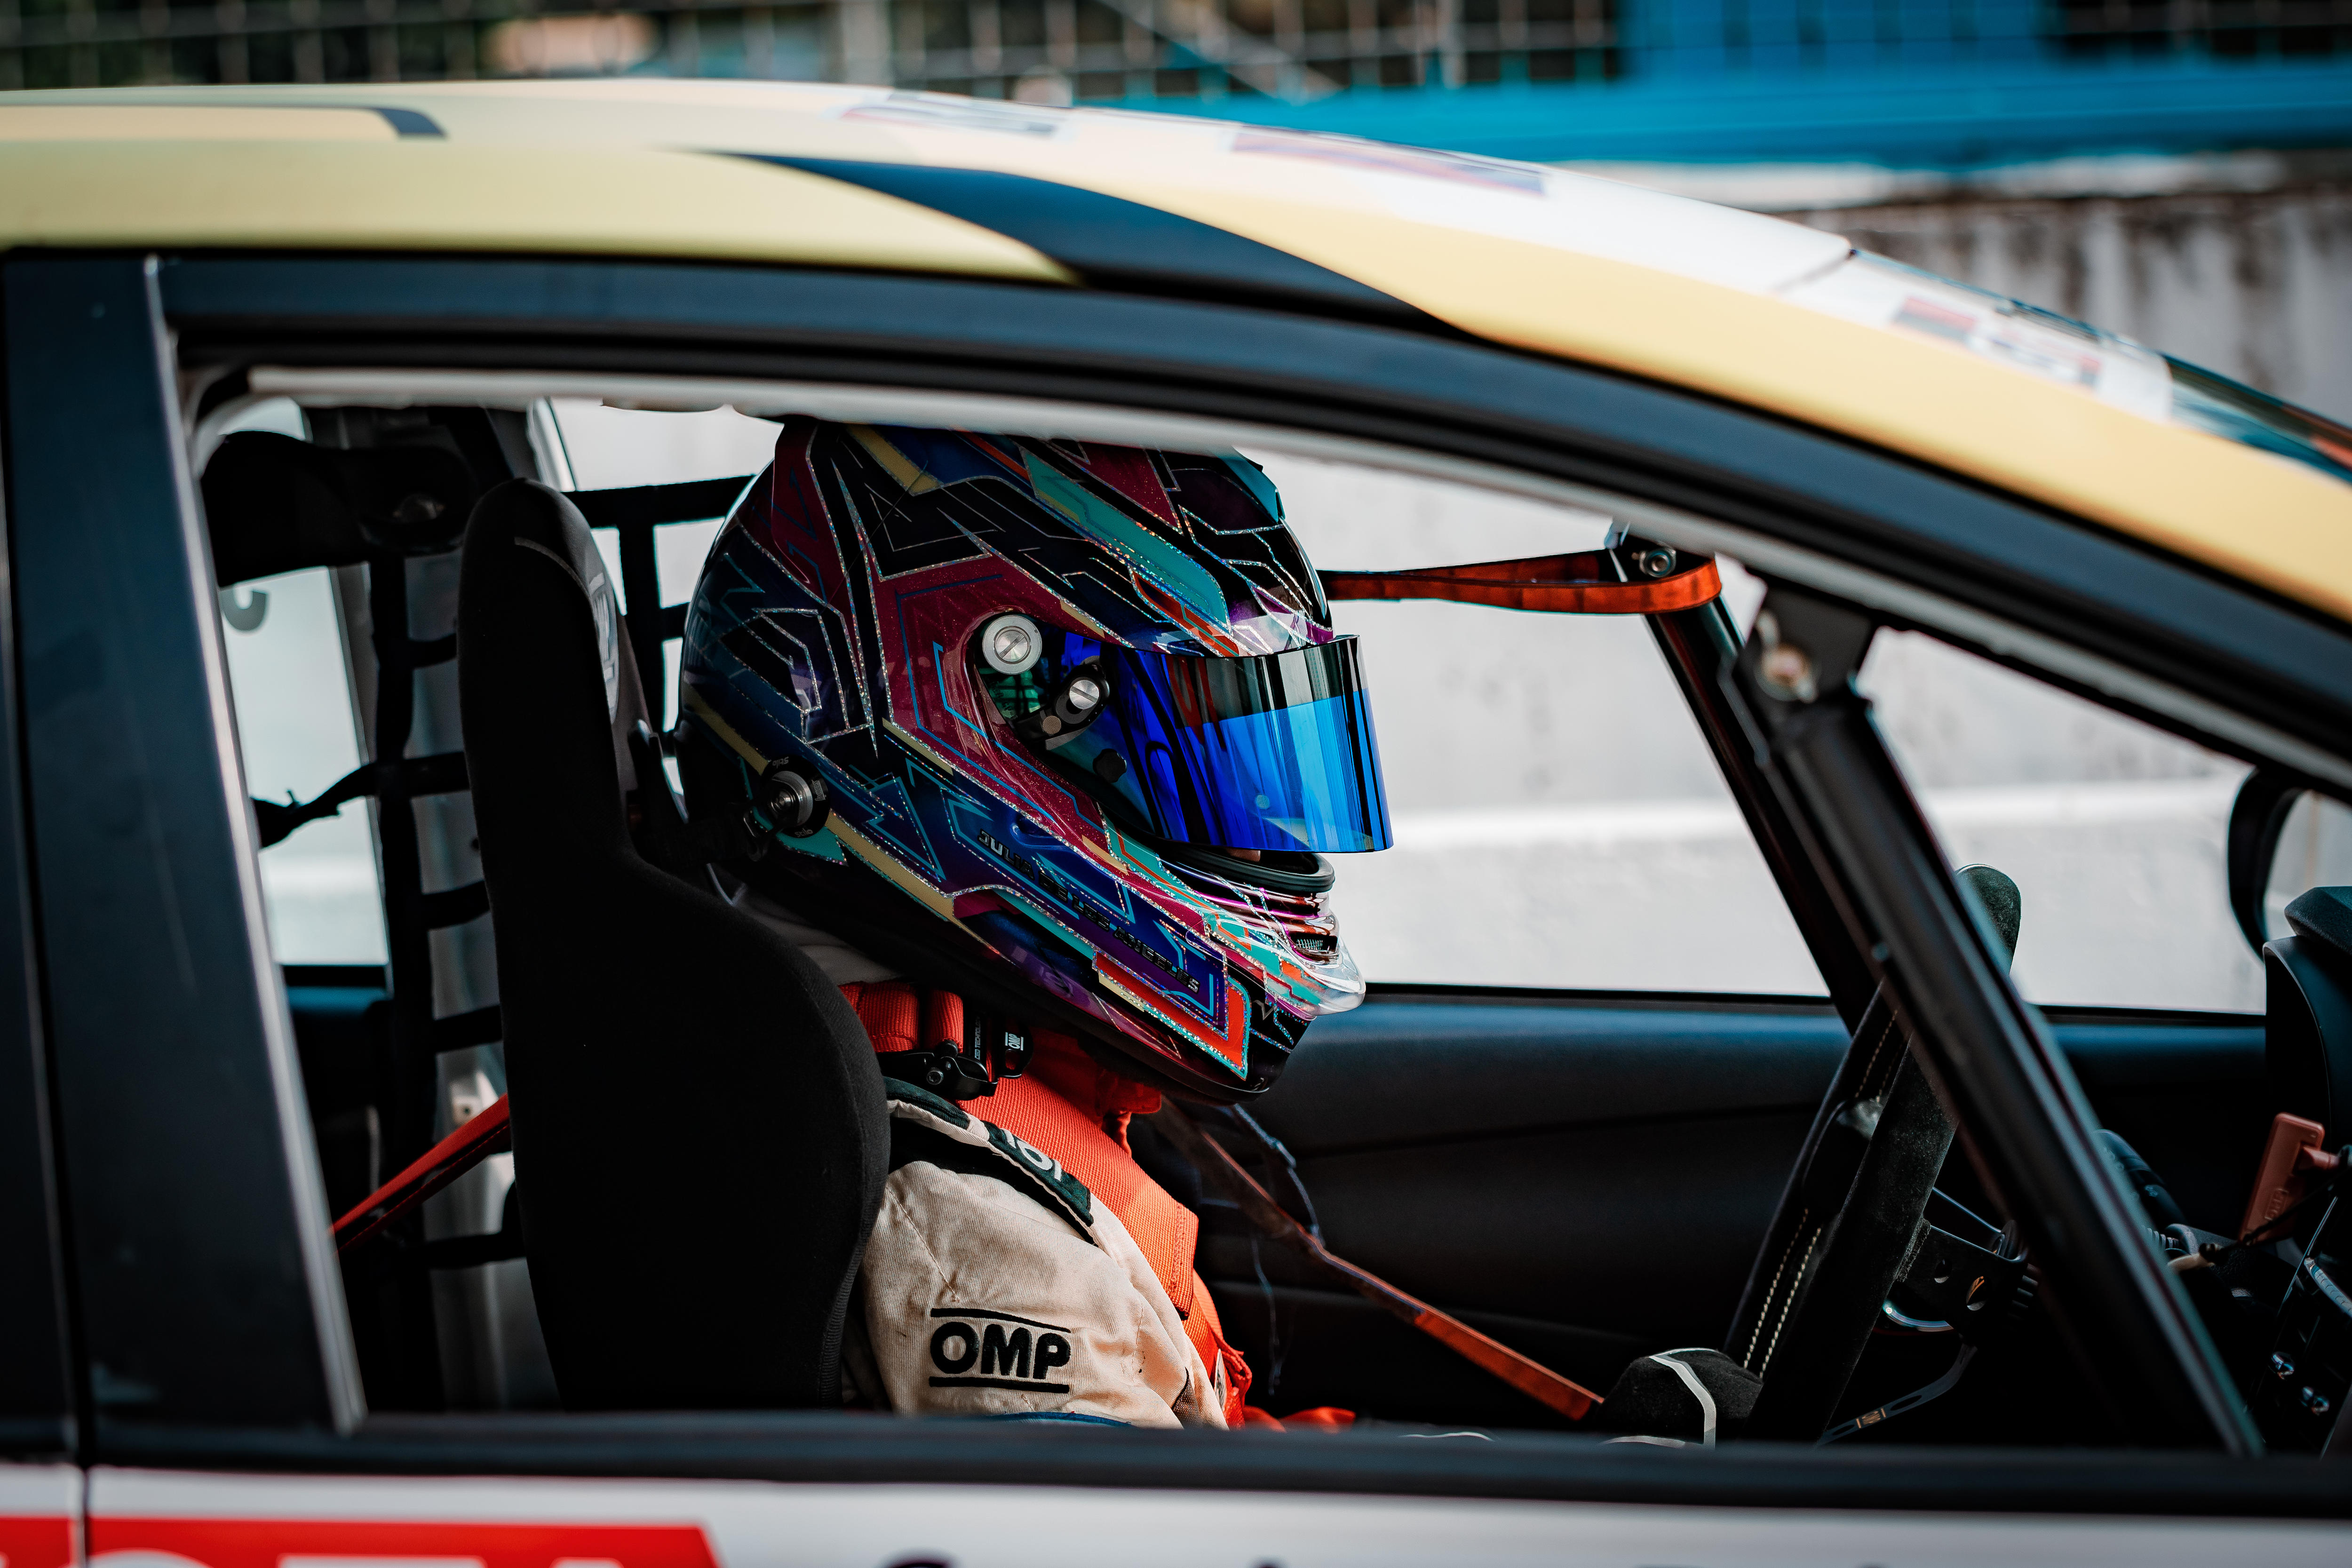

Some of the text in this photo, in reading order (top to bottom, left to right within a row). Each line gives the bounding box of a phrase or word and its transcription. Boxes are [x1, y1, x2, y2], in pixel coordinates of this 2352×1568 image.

[978, 829, 1200, 993] JULIA DE LOS ANGELES
[1009, 1034, 1020, 1049] OMP
[930, 1321, 1071, 1379] OMP
